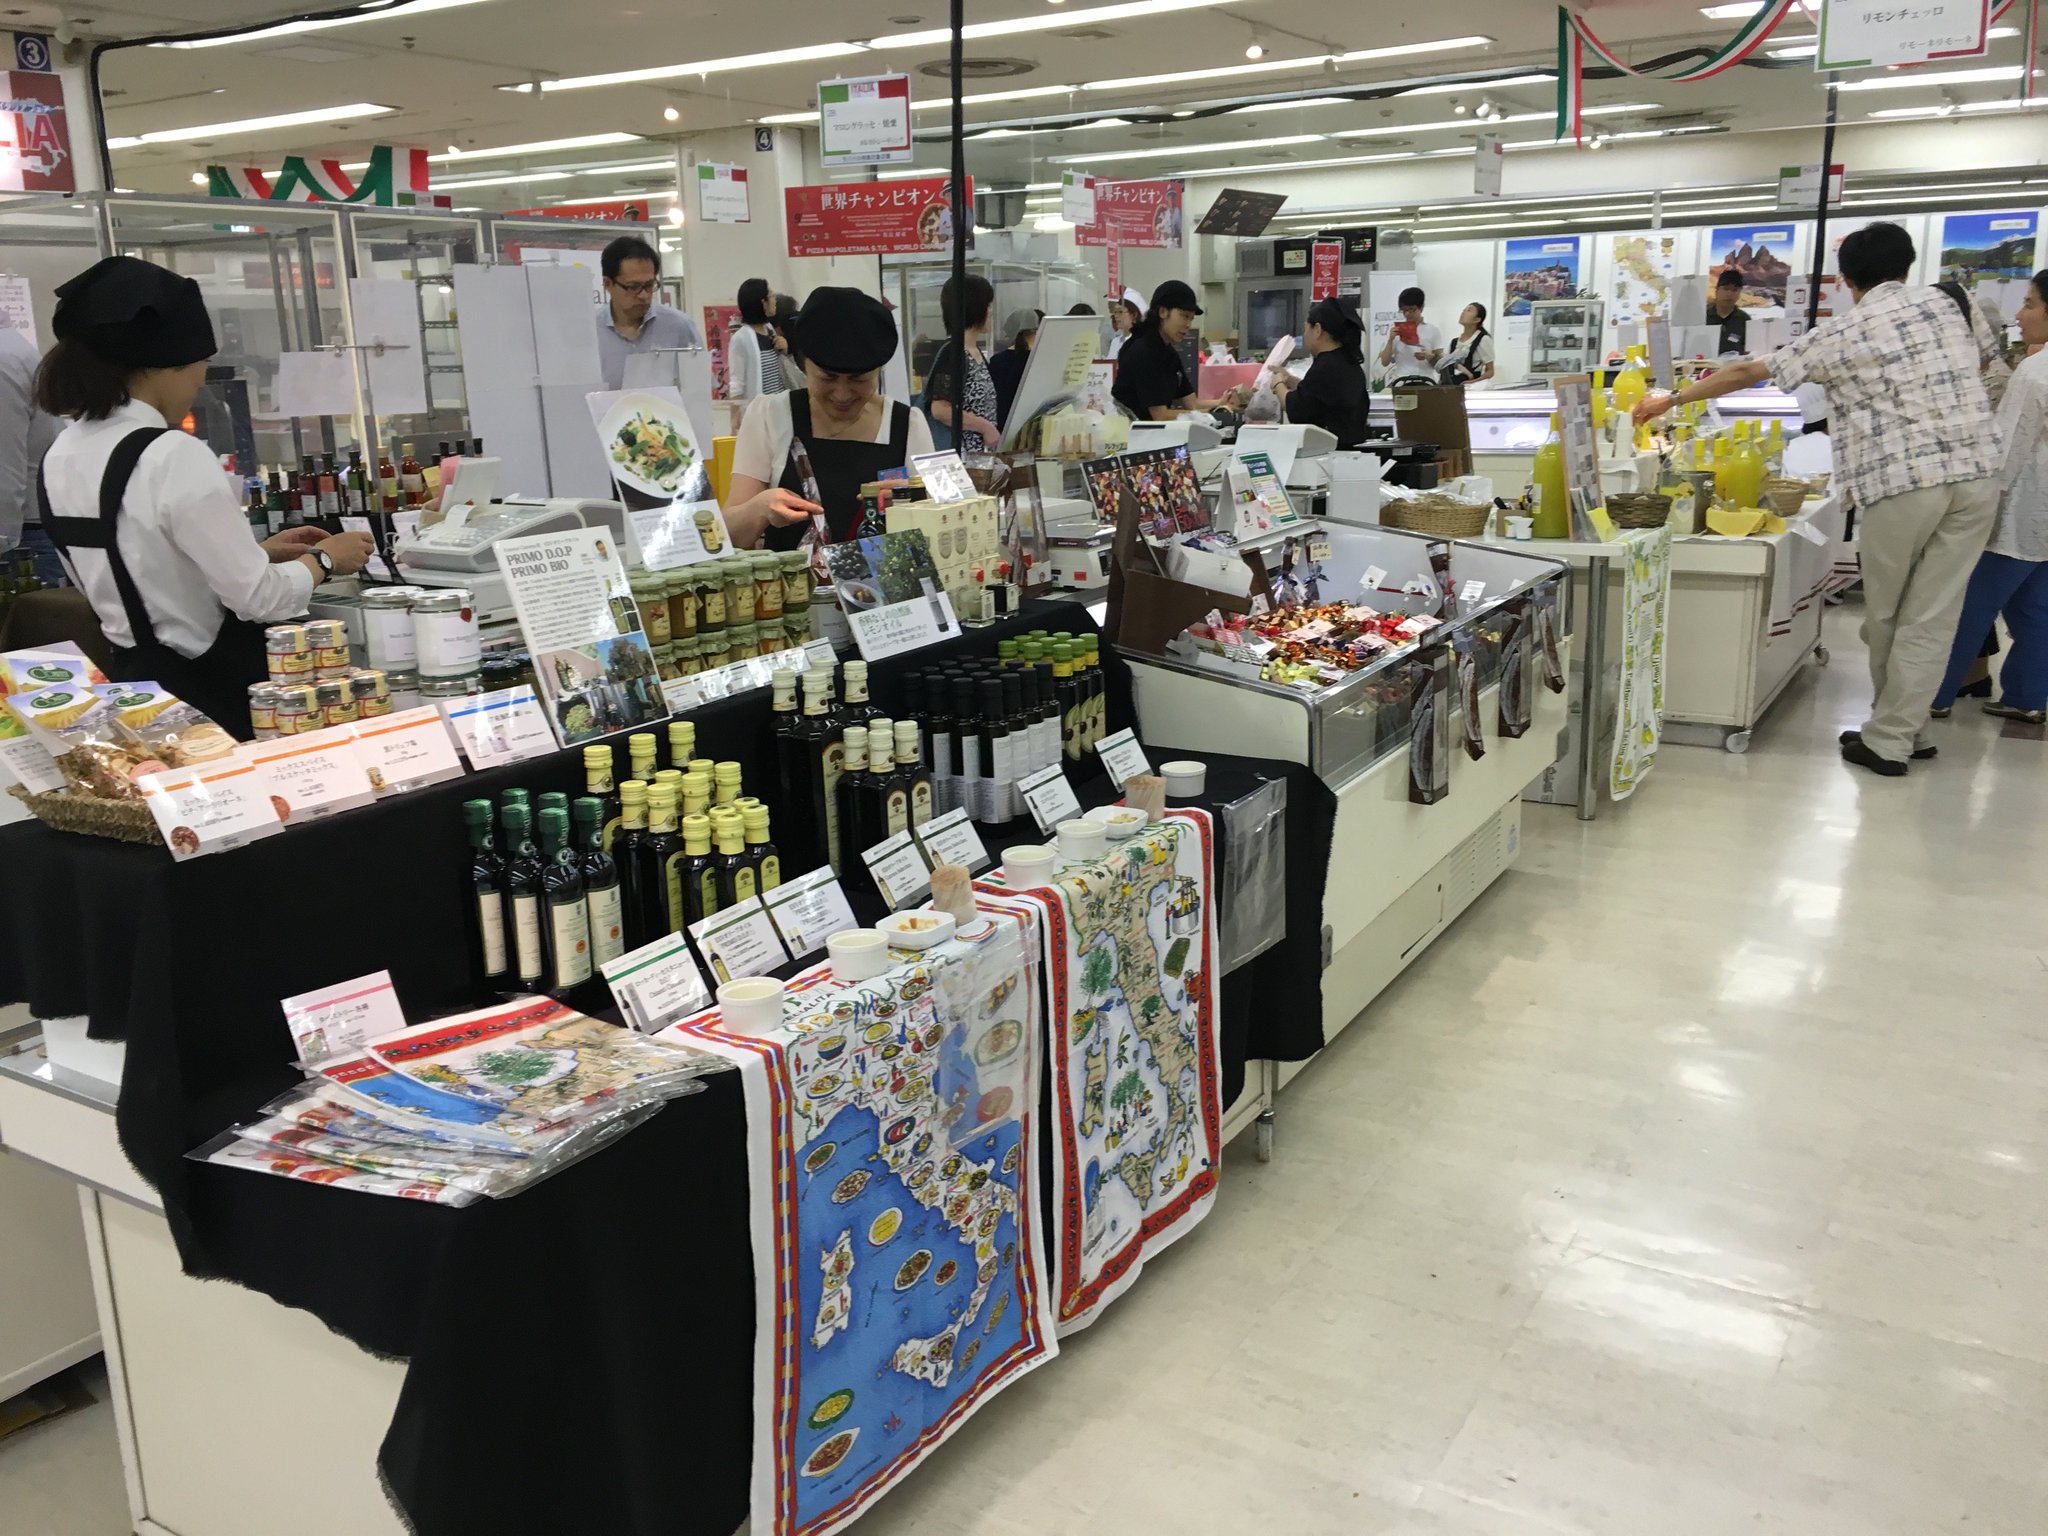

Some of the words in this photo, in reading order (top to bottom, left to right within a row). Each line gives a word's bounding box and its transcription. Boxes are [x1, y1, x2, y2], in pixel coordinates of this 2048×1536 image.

[1862, 6, 1944, 25] リモンチェッロ
[25, 41, 41, 65] 3
[759, 132, 770, 147] 4
[821, 188, 936, 211] 世界チャンピオン
[505, 549, 544, 566] PRIMO
[546, 545, 573, 559] D.O.P
[510, 562, 548, 579] PRIMO
[550, 559, 570, 573] BIO
